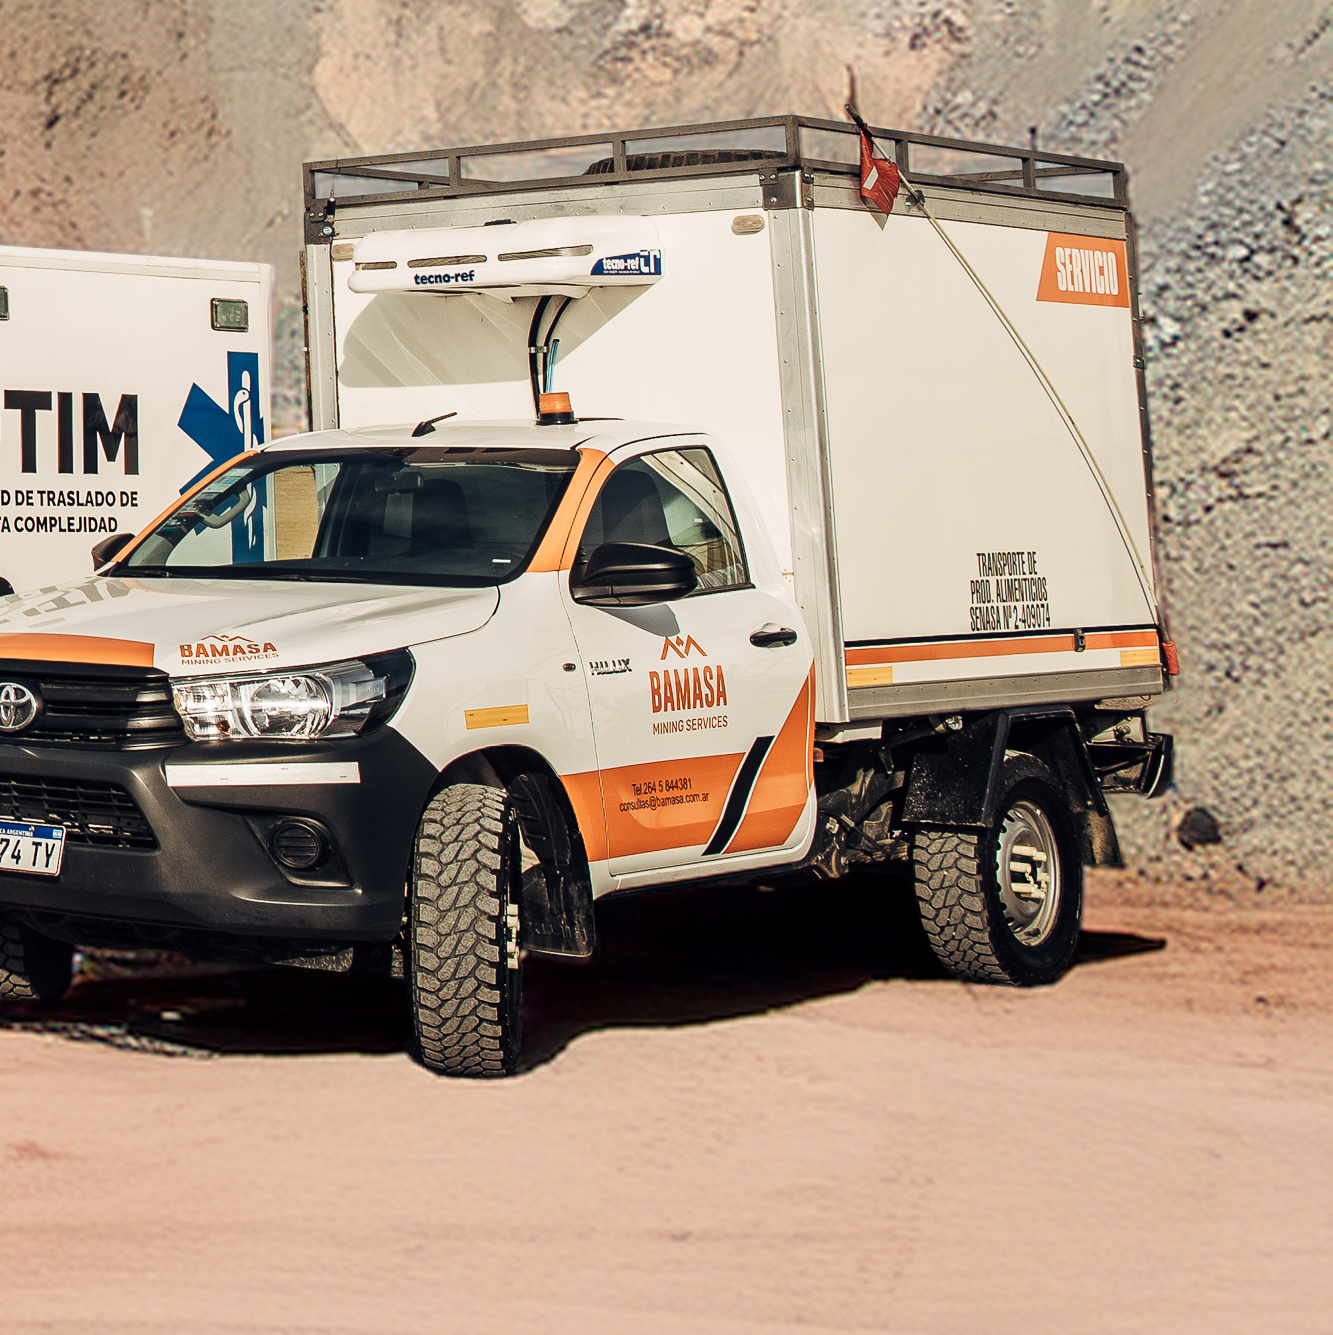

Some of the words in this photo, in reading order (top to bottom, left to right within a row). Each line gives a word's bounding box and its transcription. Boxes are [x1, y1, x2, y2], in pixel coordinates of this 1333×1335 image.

[602, 256, 639, 270] tecno-ref
[1055, 246, 1119, 296] SERVICIO
[414, 269, 475, 285] tecno-ref
[15, 489, 34, 506] DE
[37, 490, 116, 507] TRASLADO
[120, 491, 139, 507] DE
[14, 516, 118, 533] COMPLEJIDAD
[976, 551, 1027, 577] TRANSPORTE
[1027, 551, 1038, 575] DE
[970, 578, 994, 605] PROD.
[996, 577, 1048, 603] ALIMENTICIOS
[969, 605, 1002, 632] SENASA
[1013, 603, 1051, 630] 2-409074
[179, 642, 277, 658] BAMASA
[181, 658, 221, 666] MINING
[224, 652, 279, 663] SERVICES
[649, 665, 728, 714] BAMASA
[652, 720, 684, 736] MINING
[685, 715, 728, 732] SERVICES
[658, 780, 664, 792] 5
[665, 777, 692, 792] 844381
[619, 791, 709, 812] consultas@bamasa.com.ar
[32, 840, 55, 868] TY
